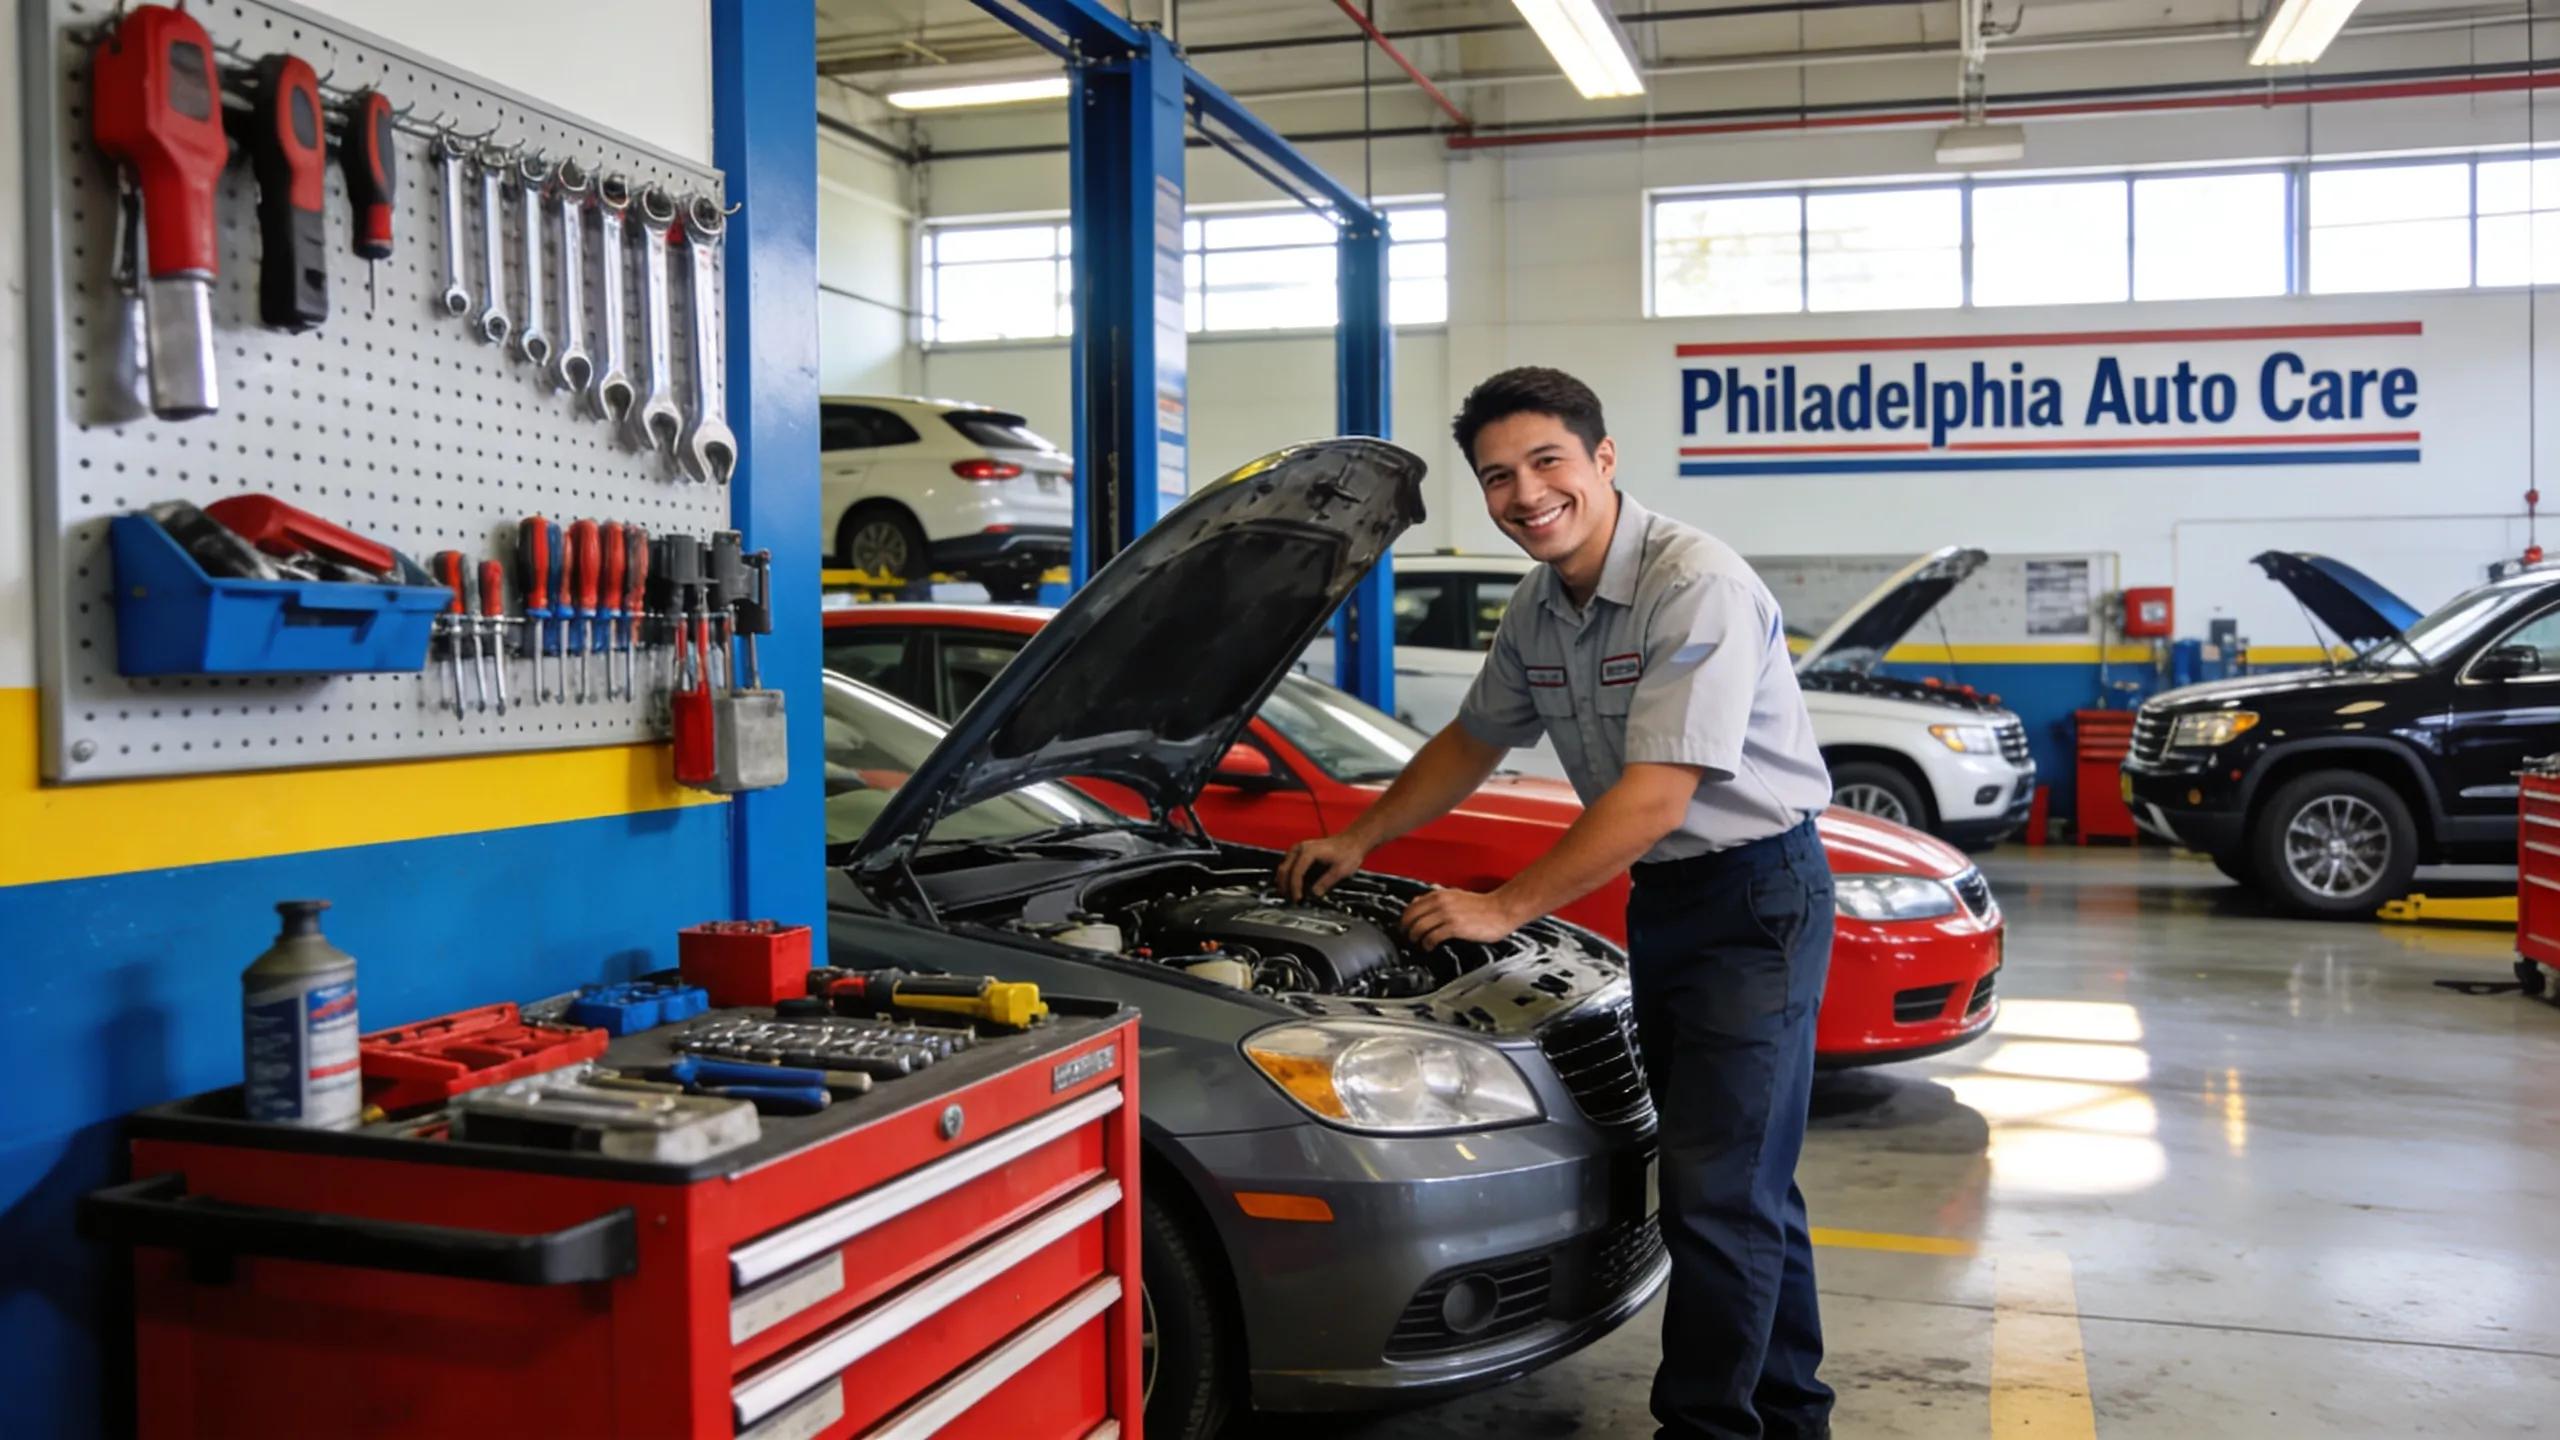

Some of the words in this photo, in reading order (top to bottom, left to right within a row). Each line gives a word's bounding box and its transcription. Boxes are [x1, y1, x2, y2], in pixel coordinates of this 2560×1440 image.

[1680, 361, 2064, 448] Philadelphia
[2084, 356, 2237, 426] Auto
[2259, 351, 2418, 422] Care
